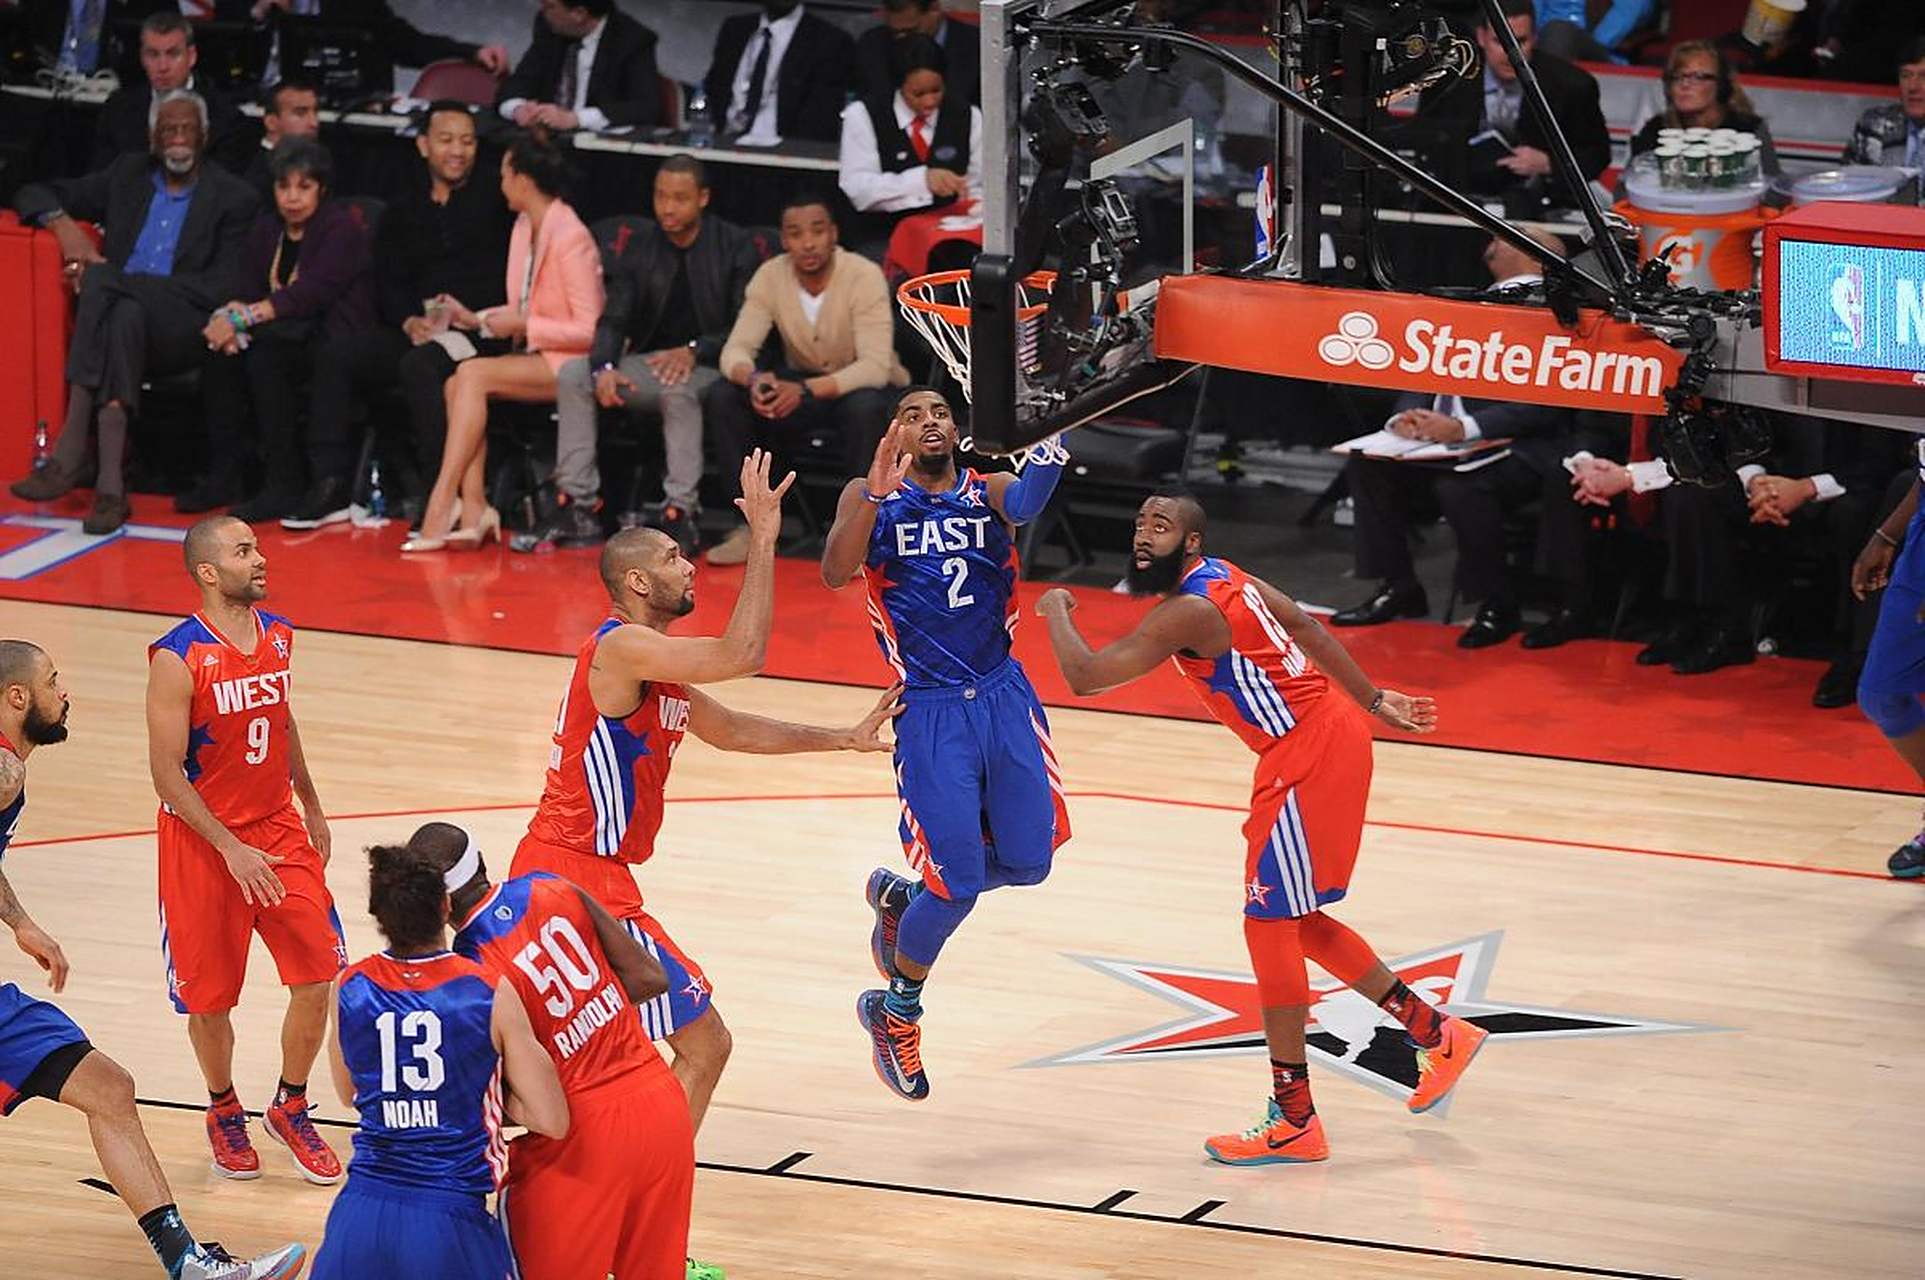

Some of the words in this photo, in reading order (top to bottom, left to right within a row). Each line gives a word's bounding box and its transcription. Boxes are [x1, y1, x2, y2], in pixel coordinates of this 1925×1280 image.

[895, 515, 991, 556] EAST
[941, 556, 975, 609] 2
[212, 669, 291, 715] WEST
[245, 716, 270, 764] 9
[512, 915, 600, 1018] 50
[375, 1010, 445, 1092] 13
[382, 1099, 439, 1129] NOAH
